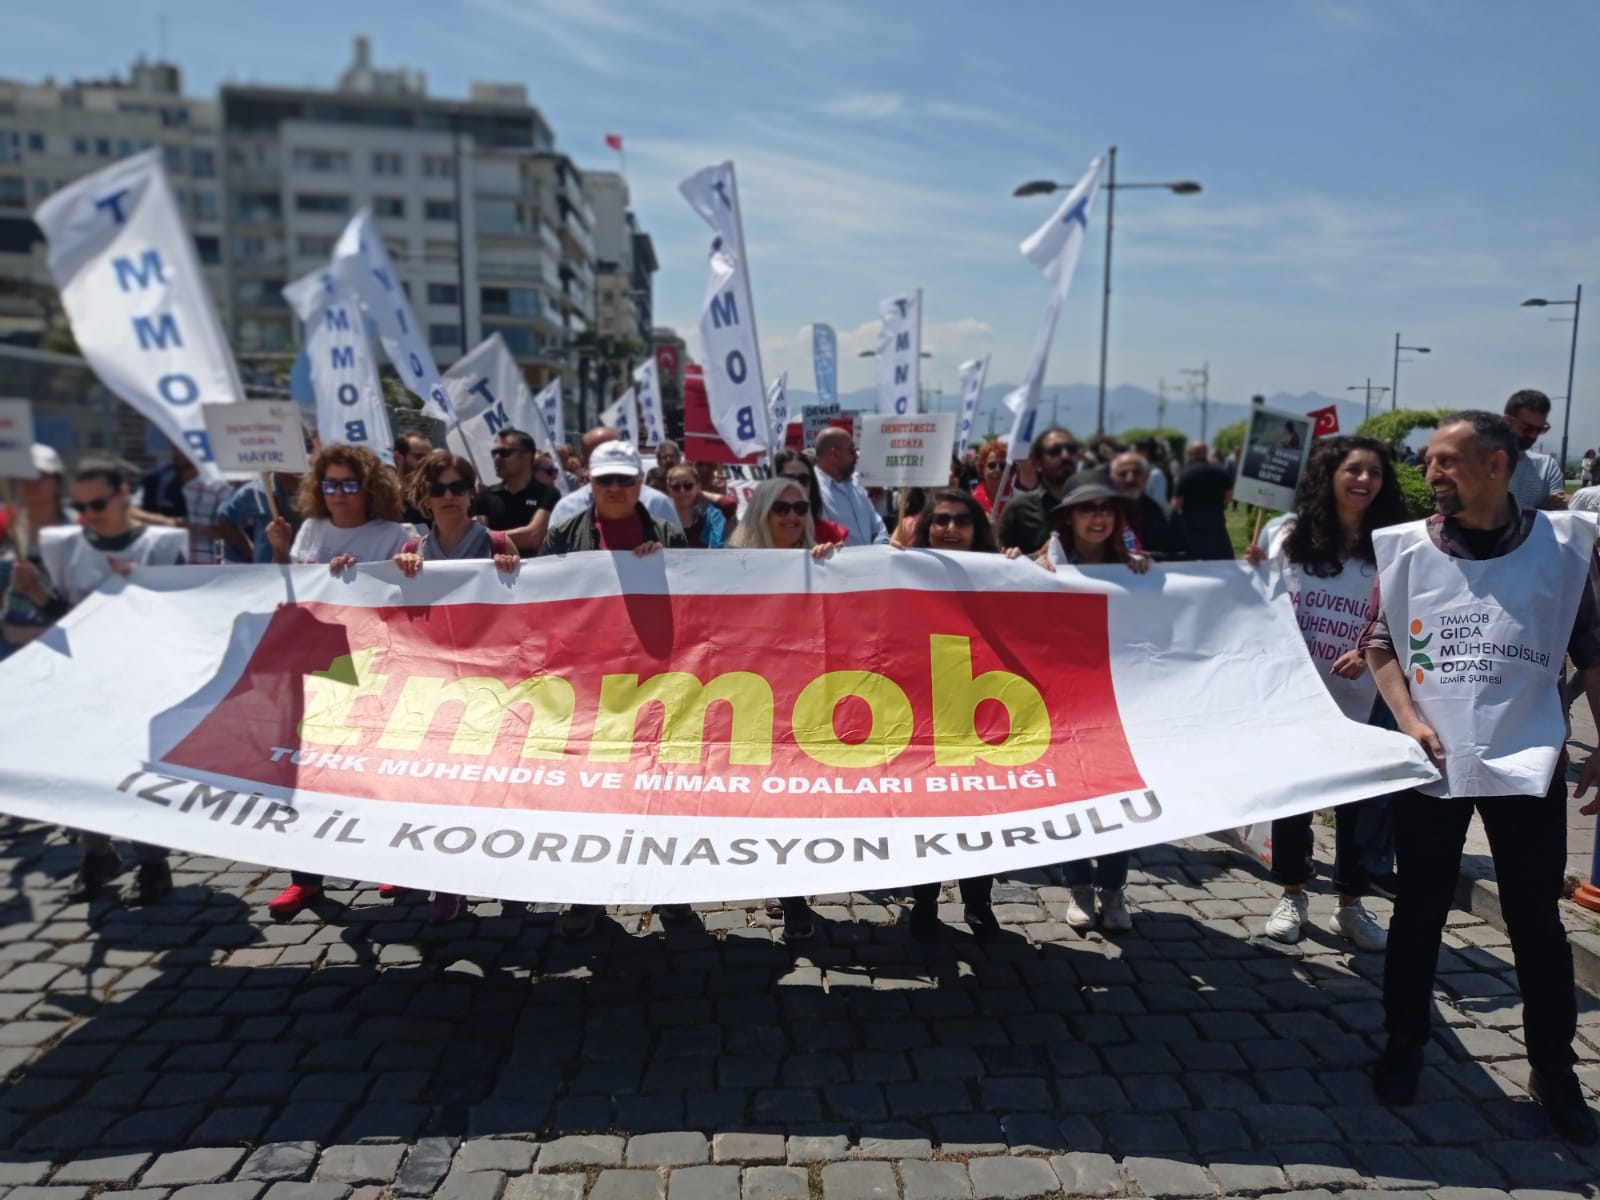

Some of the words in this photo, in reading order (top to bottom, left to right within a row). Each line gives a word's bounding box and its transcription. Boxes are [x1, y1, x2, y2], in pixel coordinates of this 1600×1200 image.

[1440, 613, 1490, 626] TMMOB
[1440, 626, 1483, 640] GIDA
[1440, 641, 1551, 668] MÜHENDİSLERİ
[1441, 659, 1493, 673] ODASI
[297, 633, 1052, 768] tmmob
[270, 746, 369, 773] TÜRK
[377, 757, 567, 787] MÜHENDİS
[580, 772, 622, 790] VE
[632, 771, 750, 794] MİMAR
[762, 775, 914, 795] ODALARI
[925, 768, 1057, 793] BİRLİĞİ
[314, 809, 367, 845] İL
[388, 821, 890, 867] KOORDİNASYON
[914, 789, 1164, 859] KURULU
